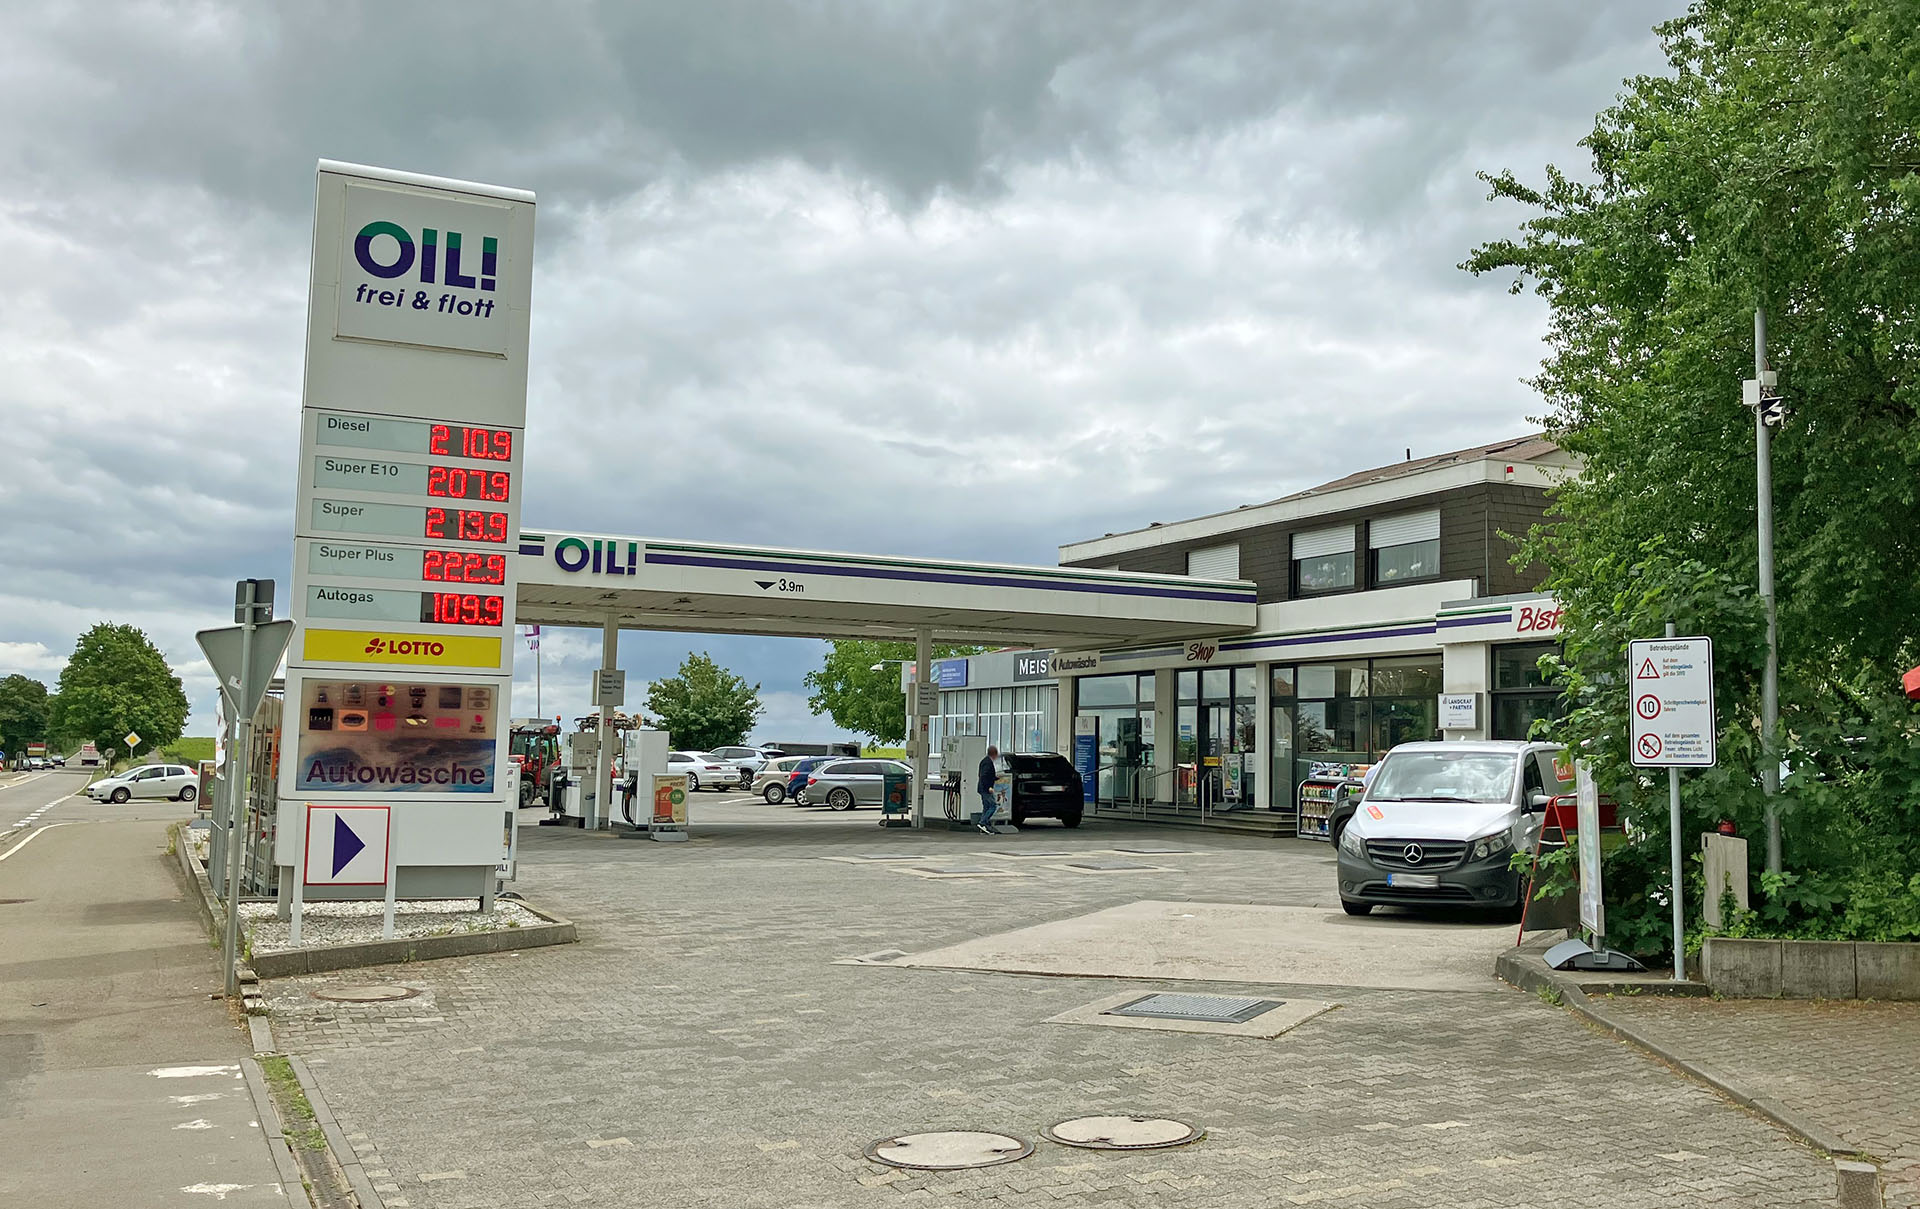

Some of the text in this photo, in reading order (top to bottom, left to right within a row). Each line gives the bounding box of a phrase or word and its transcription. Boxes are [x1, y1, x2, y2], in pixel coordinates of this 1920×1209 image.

[354, 221, 498, 291] OIL!
[356, 284, 494, 318] frei & flott
[327, 418, 370, 432] Diesel
[325, 460, 509, 501] Super E10 207.9
[322, 503, 364, 517] Super
[320, 546, 505, 584] Super Plus 222.9
[555, 537, 637, 575] OIL!
[317, 588, 504, 625] Autogas 109.9
[1517, 606, 1568, 632] Bist
[389, 640, 444, 656] LOTTO
[1187, 641, 1215, 663] Shop
[1649, 644, 1689, 652] Betriebsgelände
[1019, 658, 1049, 675] MEIS
[1058, 656, 1097, 671] Autowäsche
[1643, 700, 1655, 713] 10
[306, 760, 486, 785] Autowäsche
